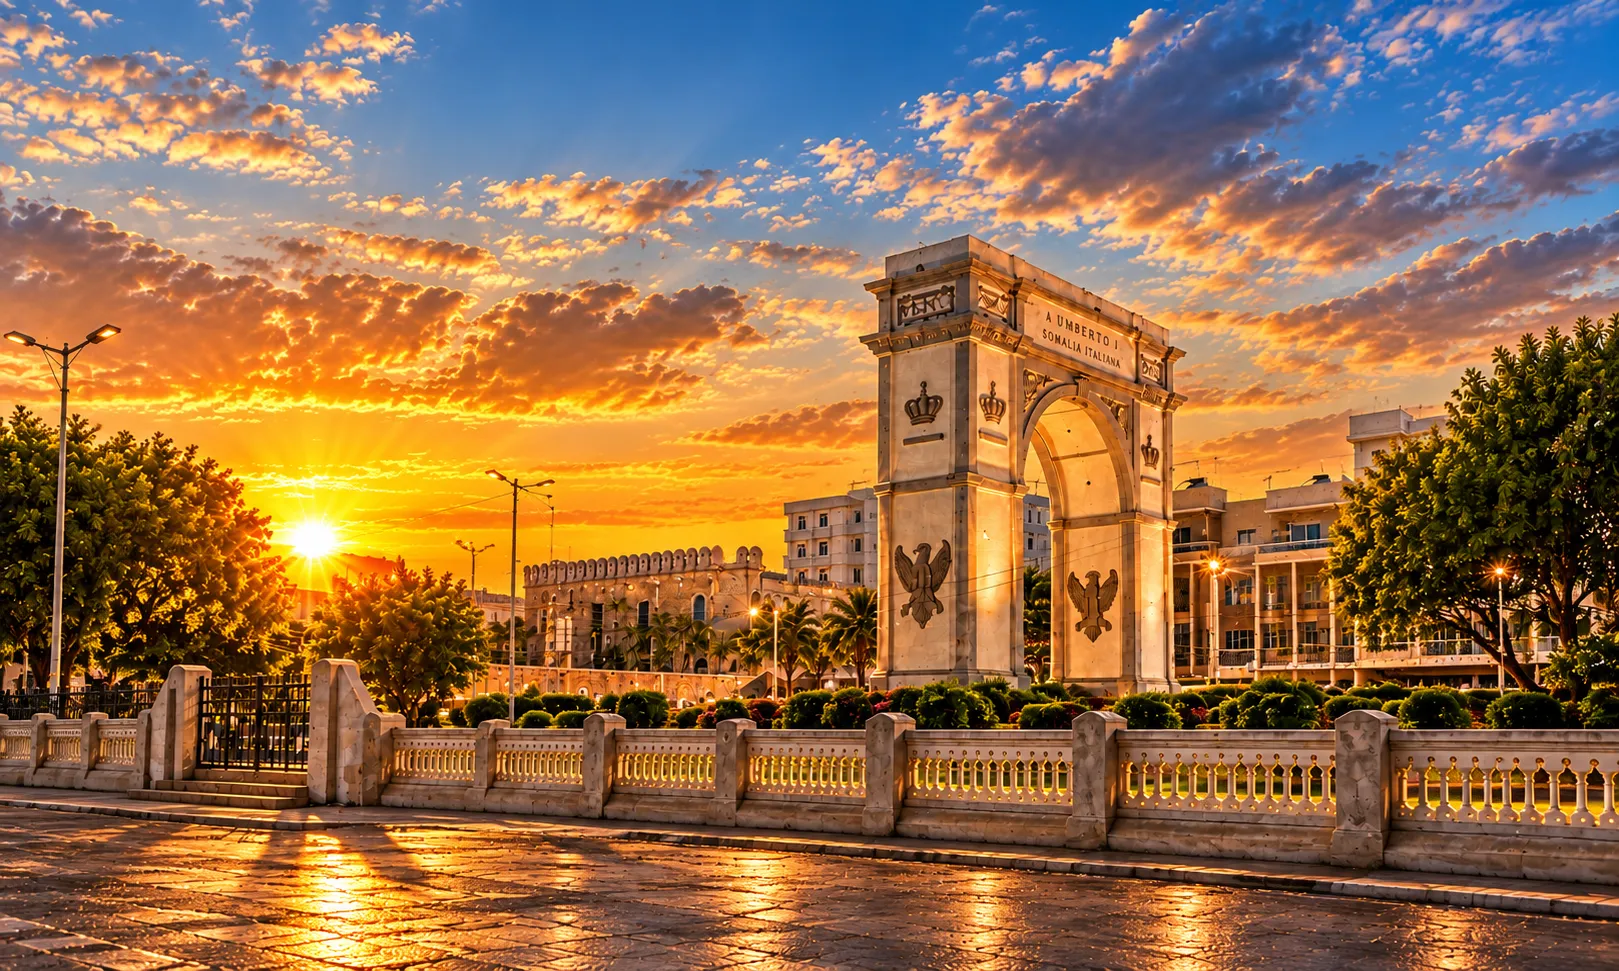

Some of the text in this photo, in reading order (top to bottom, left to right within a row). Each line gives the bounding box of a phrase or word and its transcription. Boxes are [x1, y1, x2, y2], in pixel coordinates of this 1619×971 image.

[1042, 328, 1121, 369] SOMALIA ITALIANA
[1045, 311, 1119, 350] A UMBERTO I
